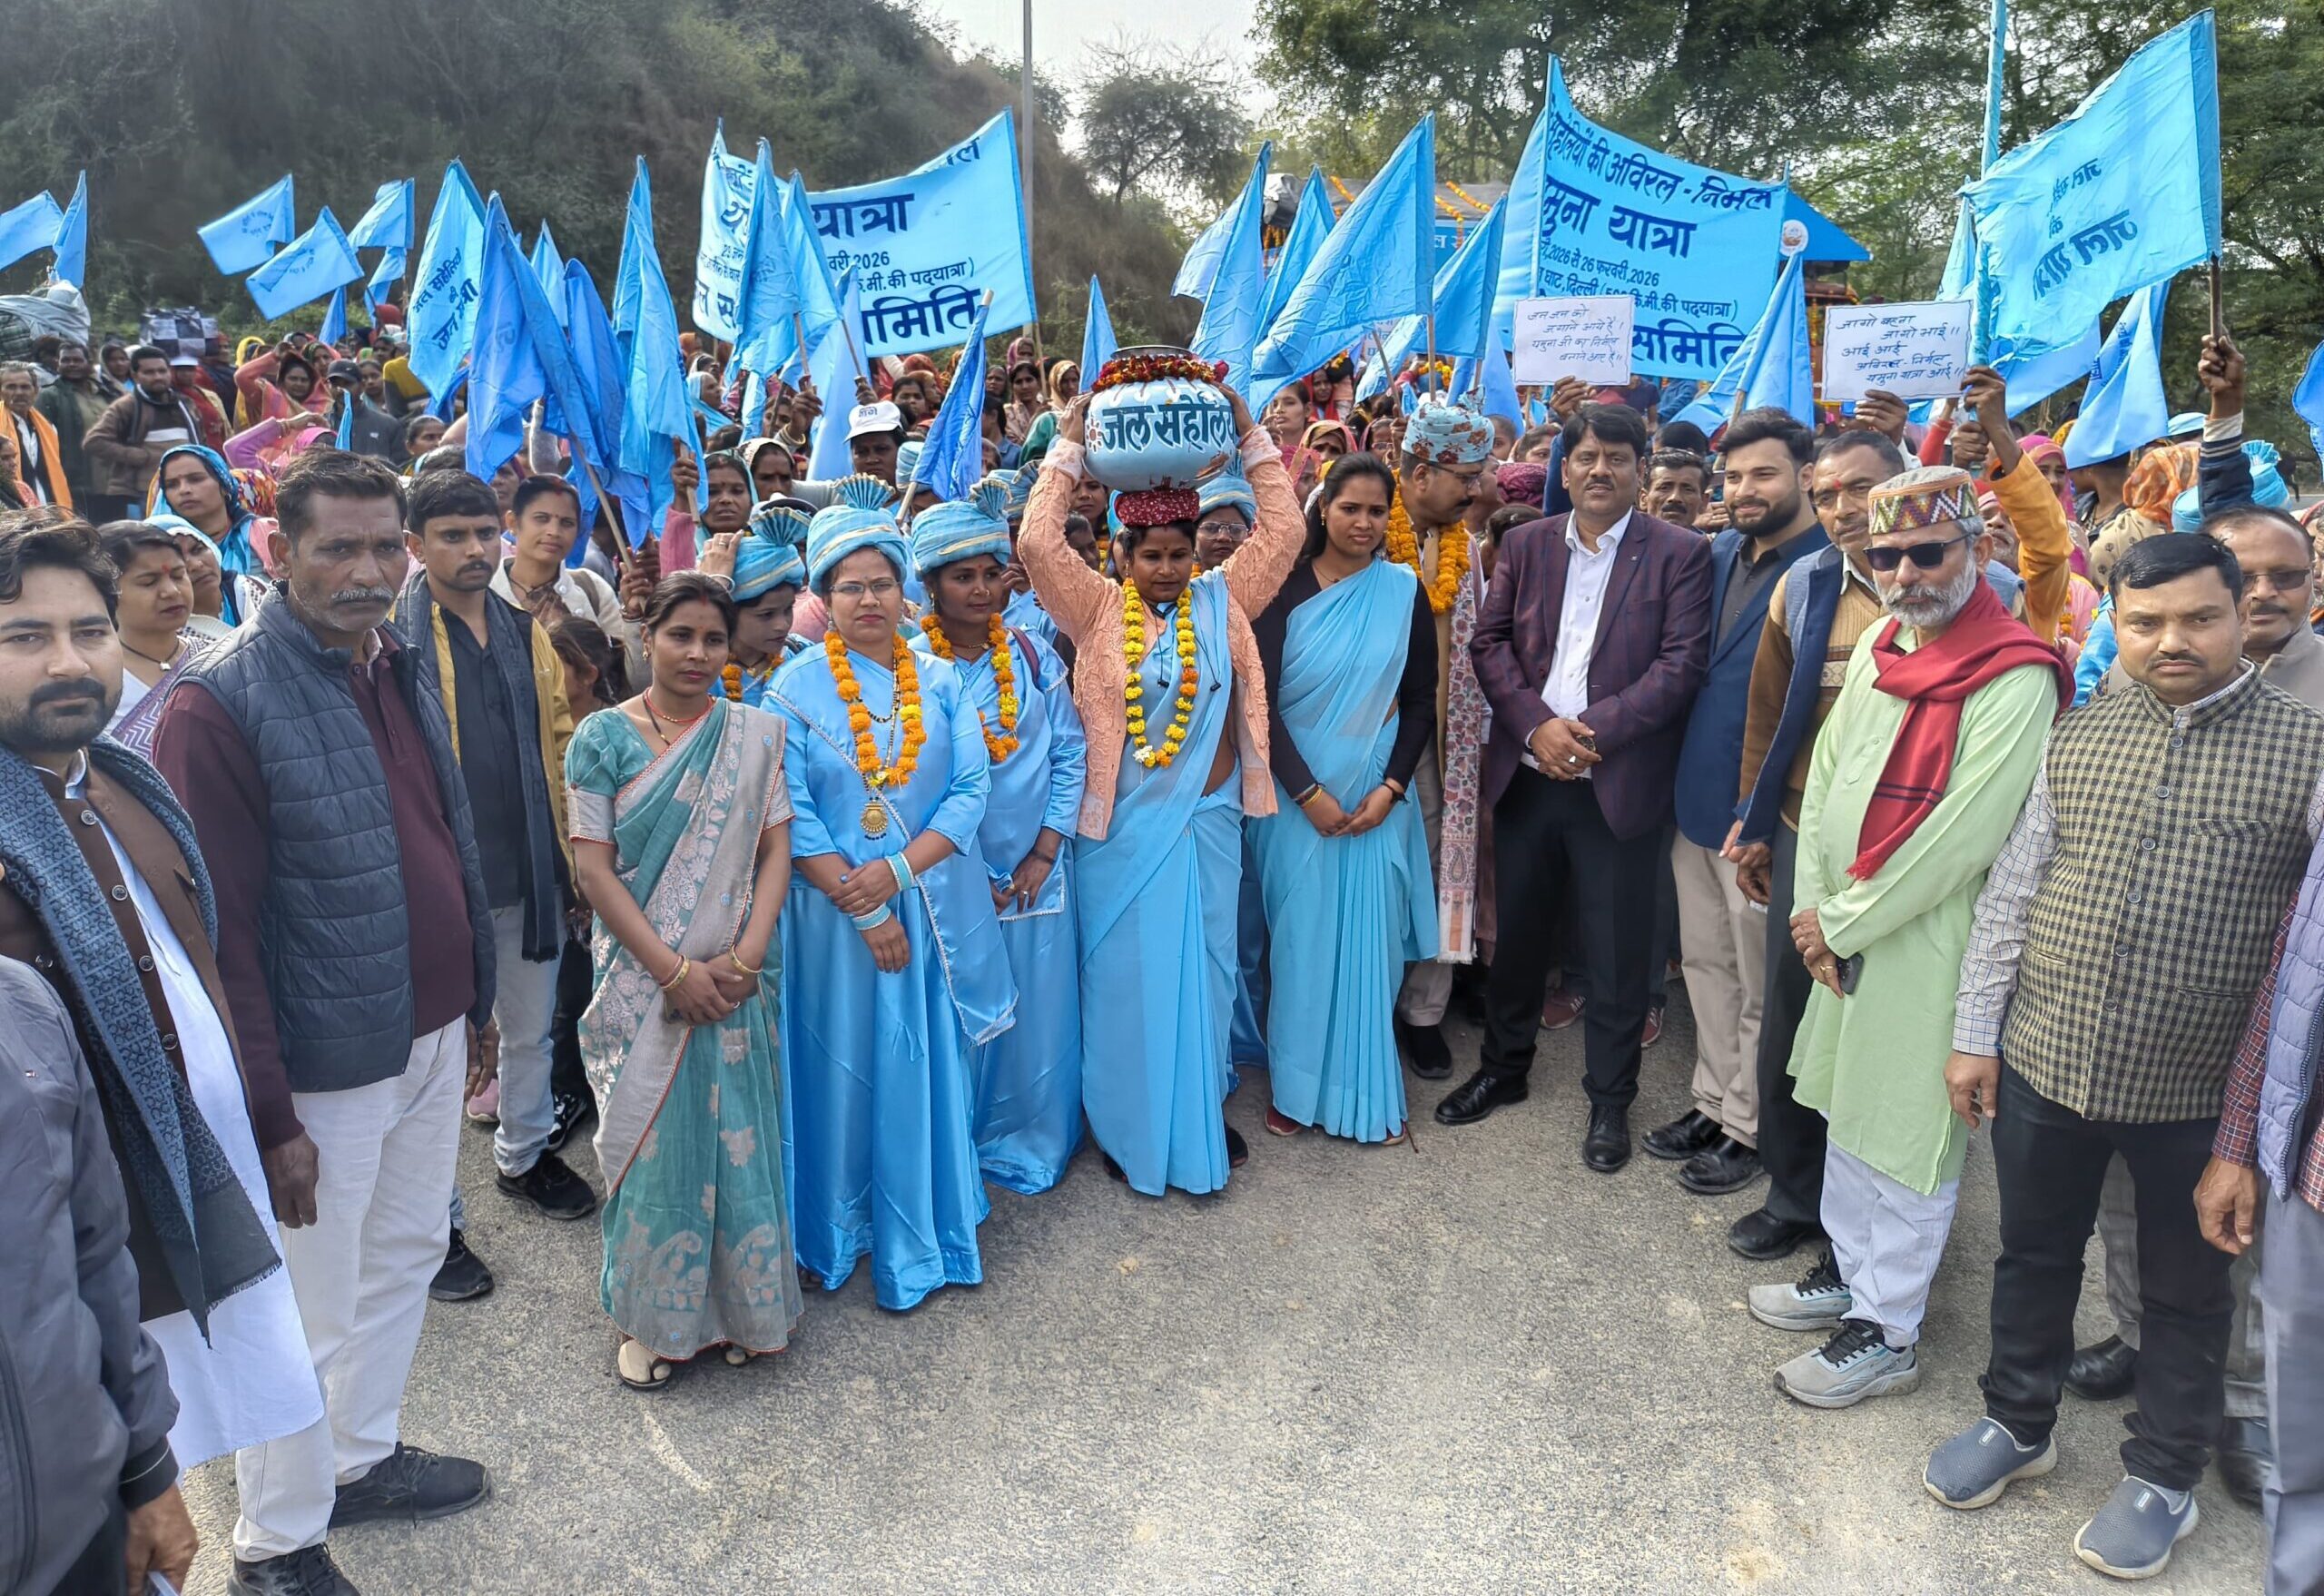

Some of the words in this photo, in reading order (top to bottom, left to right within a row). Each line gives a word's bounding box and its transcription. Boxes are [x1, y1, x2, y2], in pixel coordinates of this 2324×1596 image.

[1587, 136, 1610, 177] की
[1605, 153, 1685, 205] अविरल
[811, 193, 915, 240] यात्रा
[1541, 174, 1601, 238] मुना
[1609, 205, 1698, 260] यात्रा
[1571, 248, 1581, 269] से
[1581, 256, 1595, 272] 26
[862, 283, 981, 346] मिति
[1527, 311, 1549, 320] जन
[1549, 310, 1570, 319] जन
[1836, 313, 1877, 330] जागो
[1880, 327, 1917, 340] जागो
[1919, 322, 1947, 341] भाई
[1842, 343, 1870, 358] आई
[1875, 340, 1907, 356] आई
[1866, 372, 1897, 387] यमुना
[1926, 363, 1952, 379] आई
[1099, 406, 1156, 450] जल
